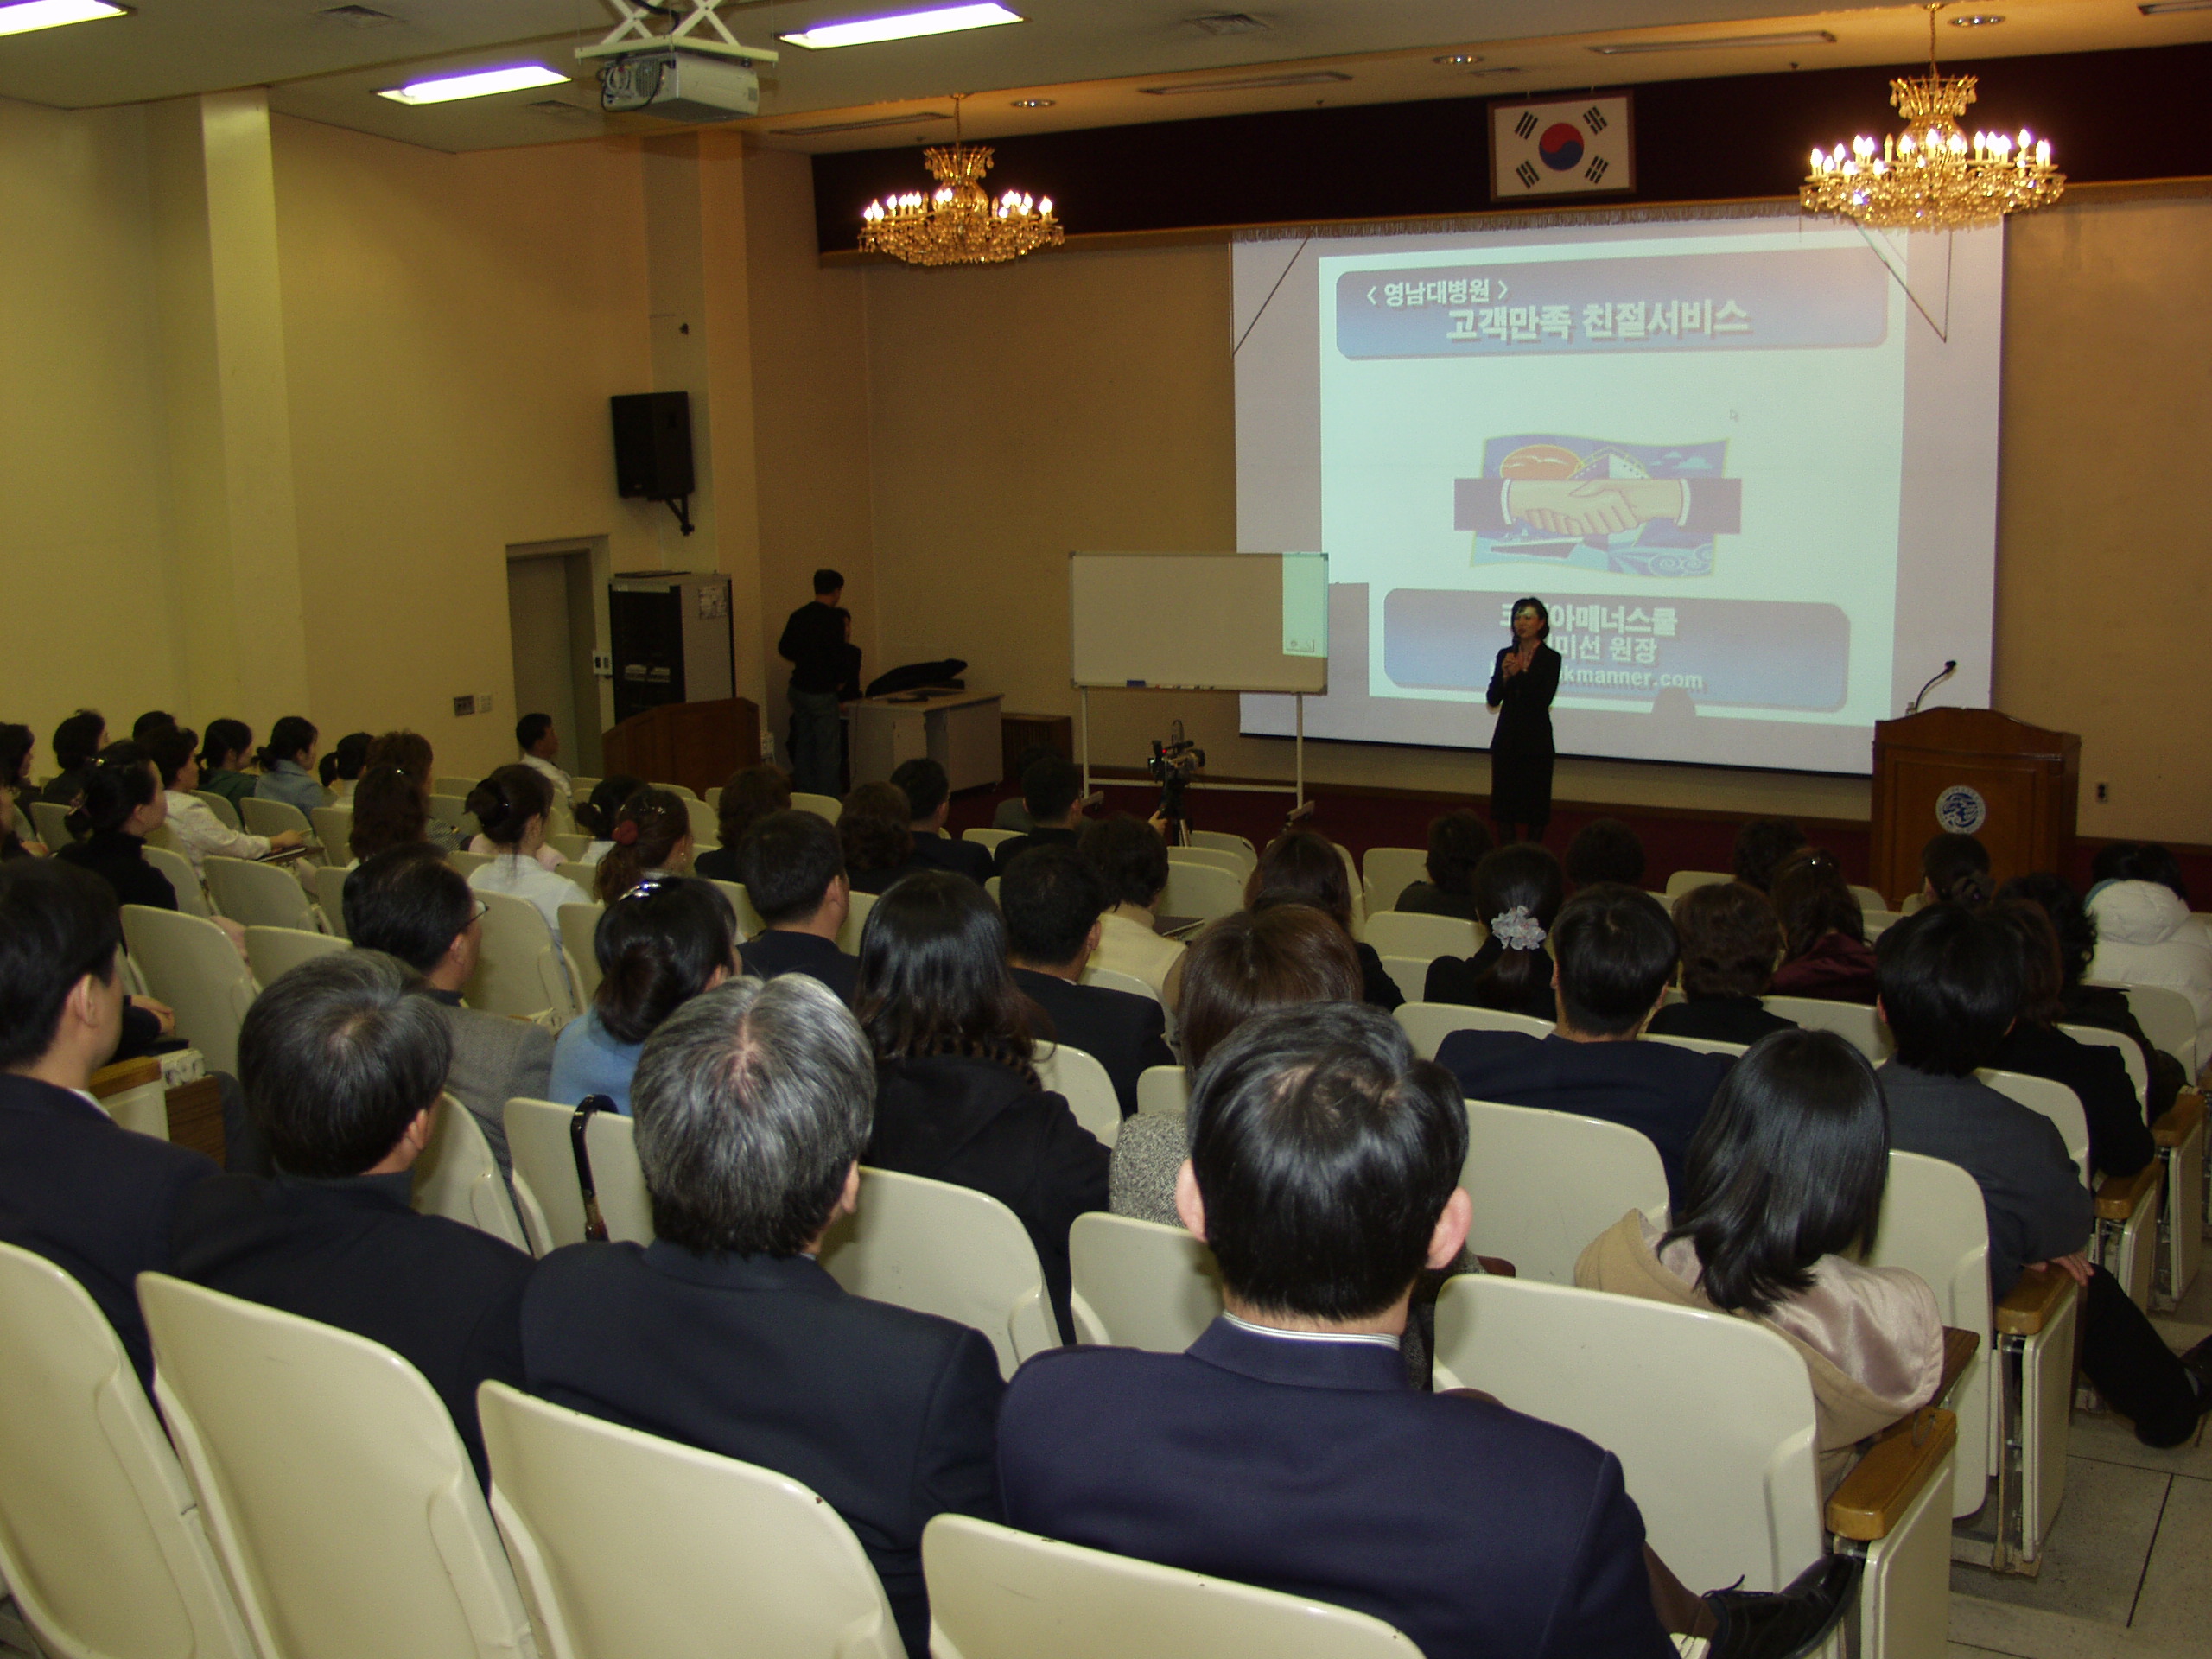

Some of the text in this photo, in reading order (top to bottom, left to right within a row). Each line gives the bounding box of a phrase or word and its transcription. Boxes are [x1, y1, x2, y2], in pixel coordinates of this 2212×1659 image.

[1446, 299, 1750, 341] 고객만족 친절서비스
[1499, 602, 1678, 637] 아매너스쿨
[1545, 634, 1658, 664] 미선 원장
